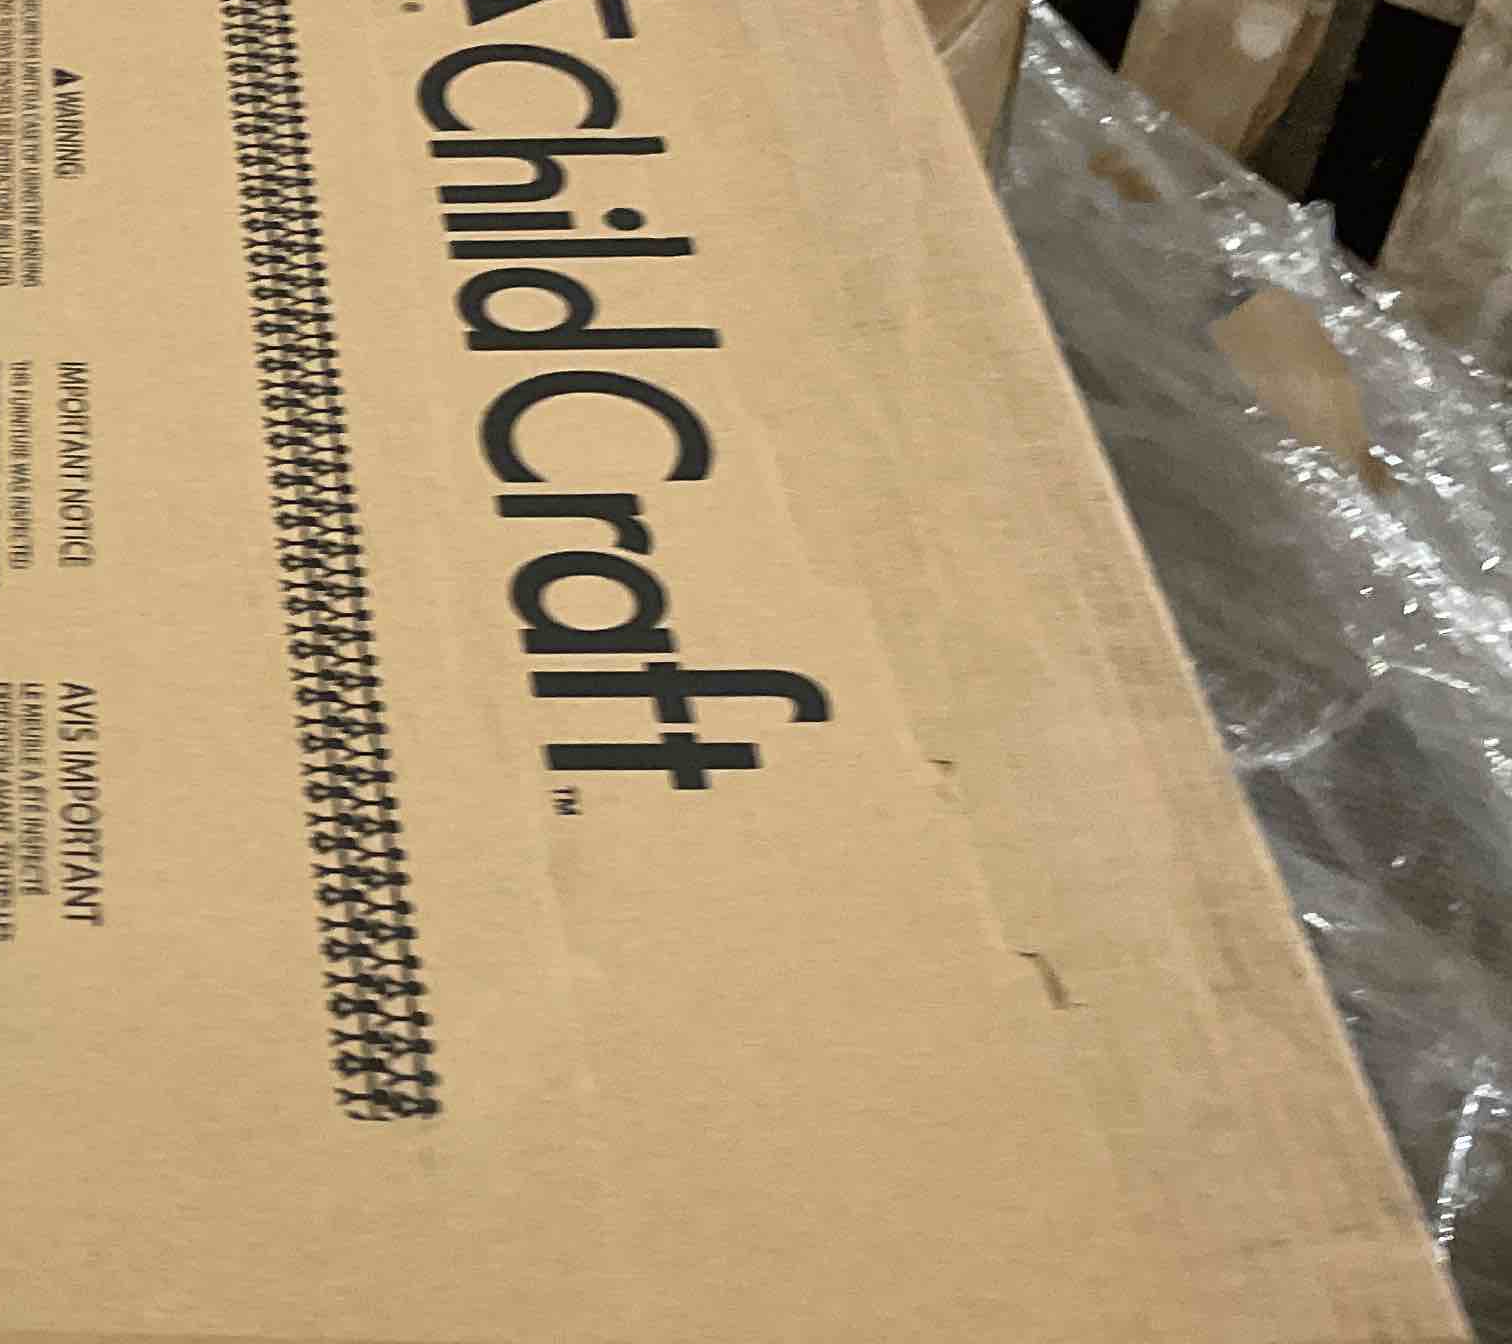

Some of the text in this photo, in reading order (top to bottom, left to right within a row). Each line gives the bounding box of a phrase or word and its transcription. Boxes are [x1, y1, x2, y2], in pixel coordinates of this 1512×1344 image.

[55, 360, 94, 567] IMPORTANT NOTICE
[417, 42, 829, 789] ChildCraft
[60, 682, 103, 926] AVIS IMPORTANT
[433, 786, 461, 816] TM
